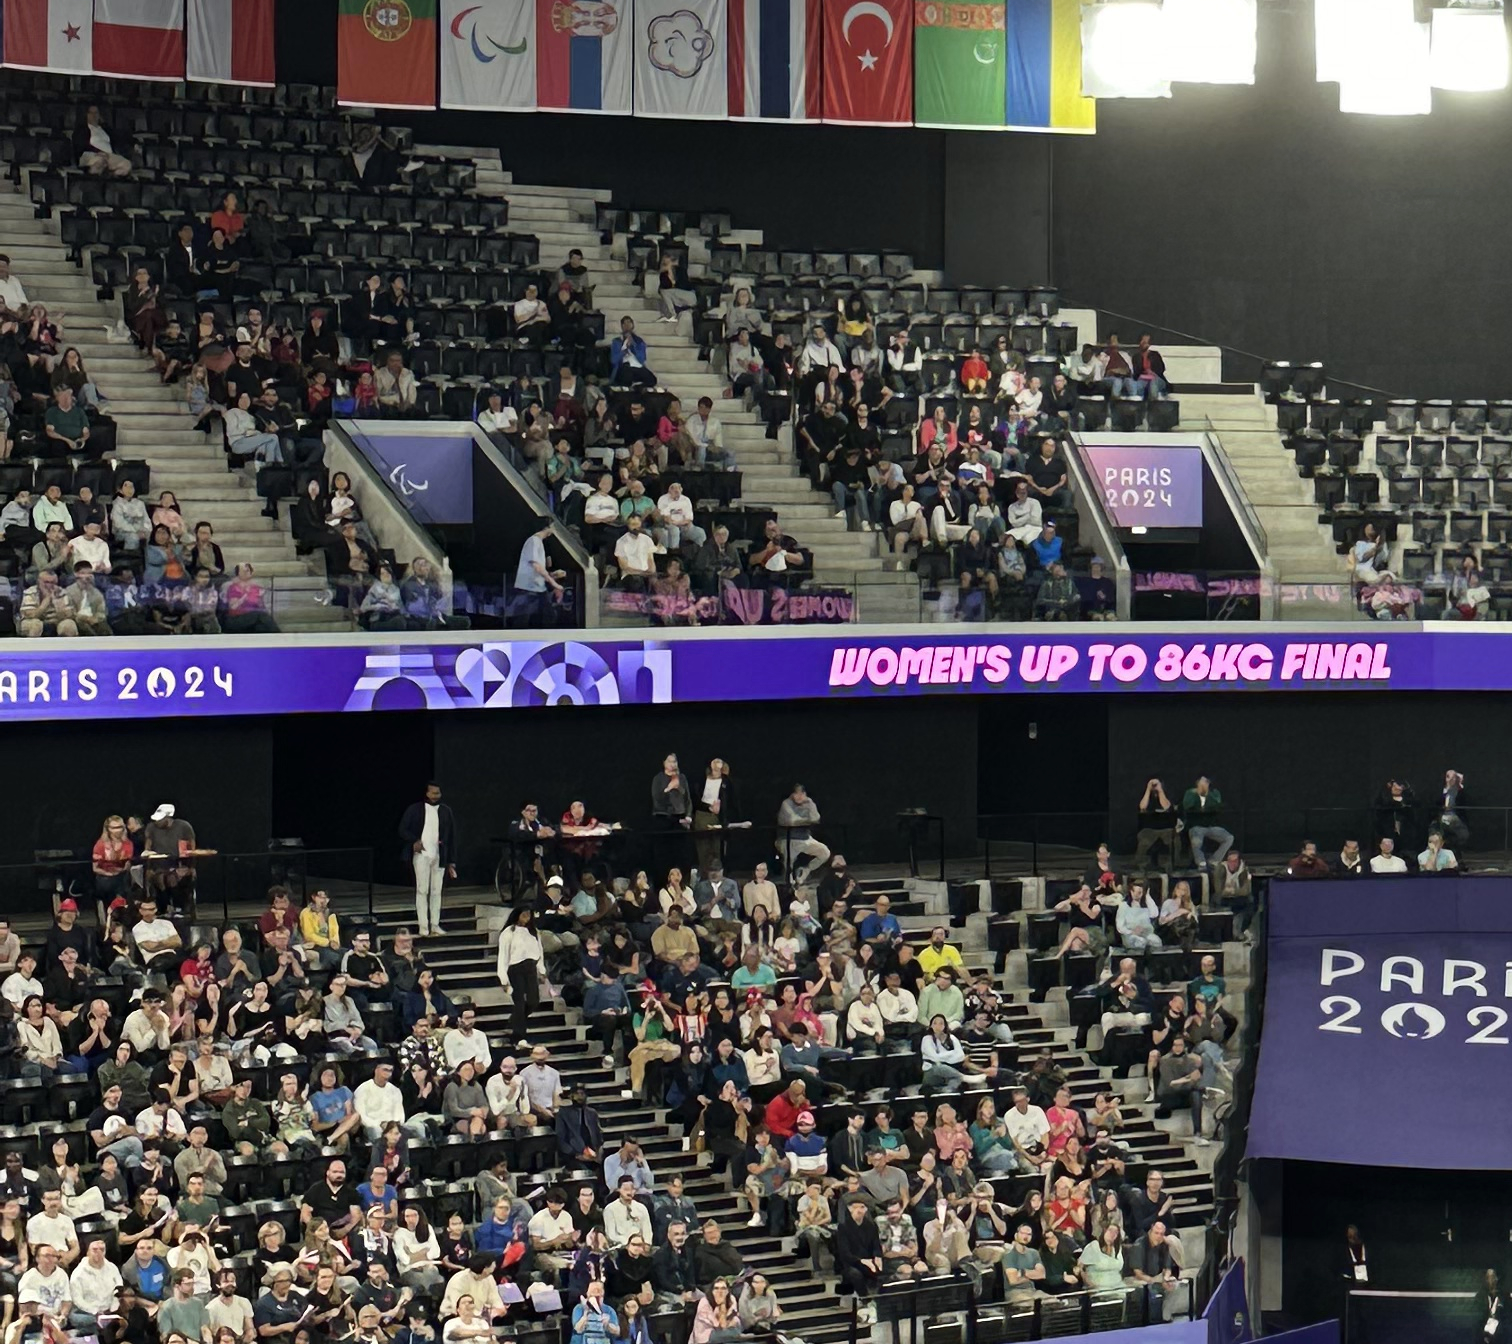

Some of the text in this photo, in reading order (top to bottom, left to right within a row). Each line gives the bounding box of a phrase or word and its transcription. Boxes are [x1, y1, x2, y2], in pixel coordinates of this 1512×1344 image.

[1105, 467, 1171, 485] PARIS
[829, 642, 1391, 685] WOMEN'S UP TO 86KG FINAL
[118, 666, 233, 700] 2024
